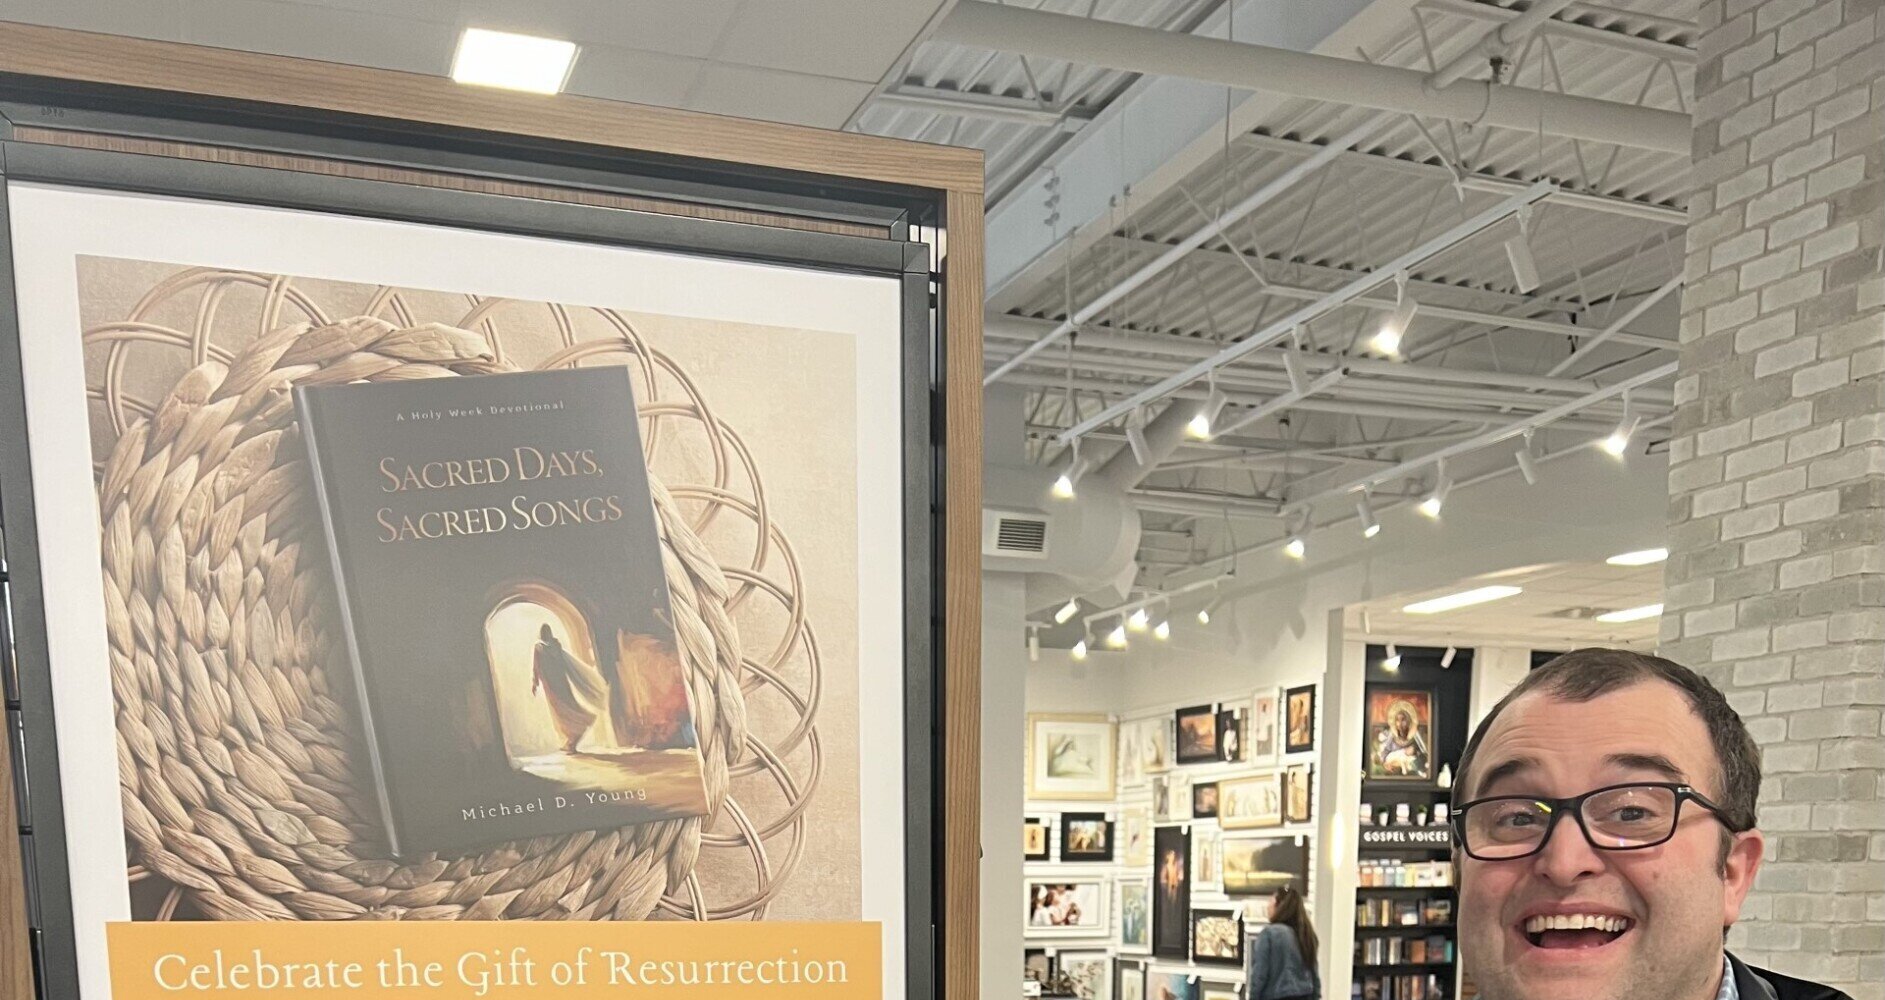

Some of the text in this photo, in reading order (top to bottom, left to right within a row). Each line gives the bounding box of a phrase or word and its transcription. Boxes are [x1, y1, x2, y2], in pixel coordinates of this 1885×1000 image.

[397, 401, 564, 421] A Holy Week Devotional
[379, 446, 603, 492] SACRED DAYS,
[376, 495, 623, 542] SACRED SONGS
[462, 788, 647, 820] Michael D. Young
[1363, 831, 1449, 842] GOSPEL VOICES
[154, 947, 849, 996] Celebrate the Gift of Resurrection
